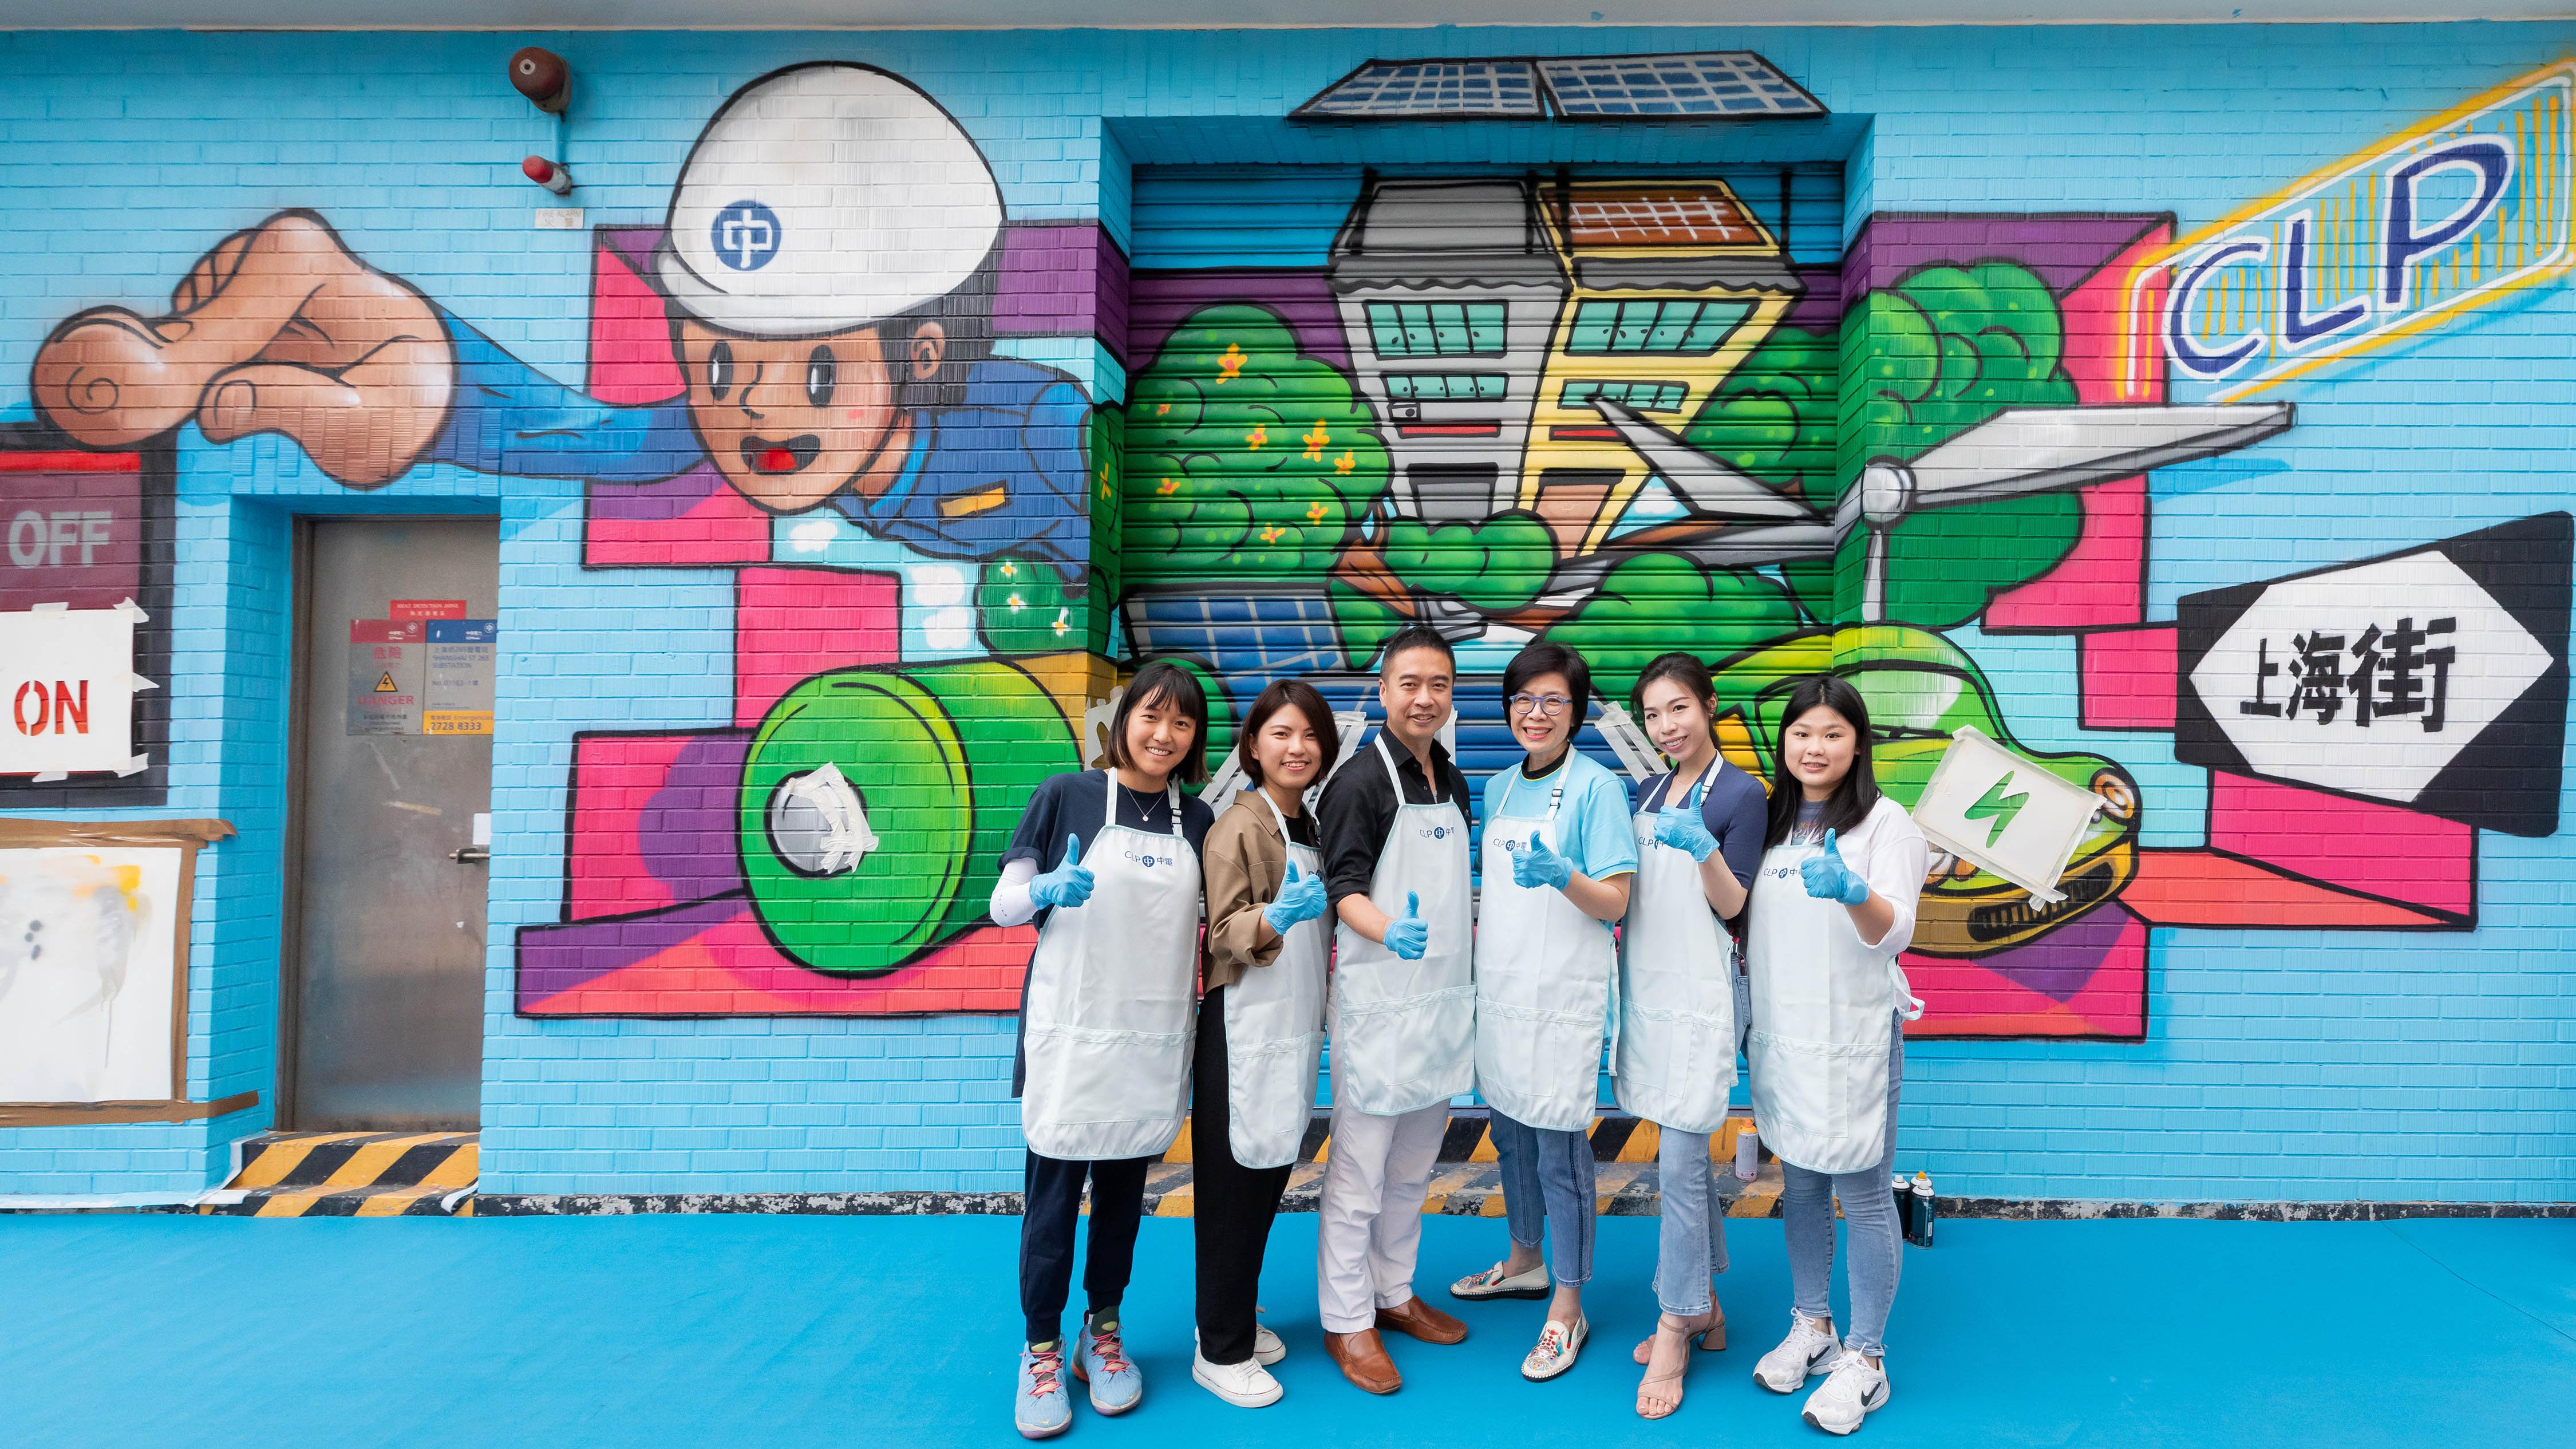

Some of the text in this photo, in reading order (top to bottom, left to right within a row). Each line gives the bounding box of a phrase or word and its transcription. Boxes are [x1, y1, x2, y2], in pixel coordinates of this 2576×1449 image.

[2164, 136, 2514, 378] CLP
[9, 510, 112, 568] OFF
[2240, 617, 2456, 732] 上海街
[357, 695, 414, 705] DANGER
[14, 680, 89, 736] ON
[430, 722, 481, 730] 2728 8333
[1420, 829, 1432, 838] CLP
[1493, 838, 1505, 847] CLP
[1638, 836, 1653, 847] CLP
[1124, 851, 1140, 862] CLP
[1763, 868, 1777, 876] CLP
